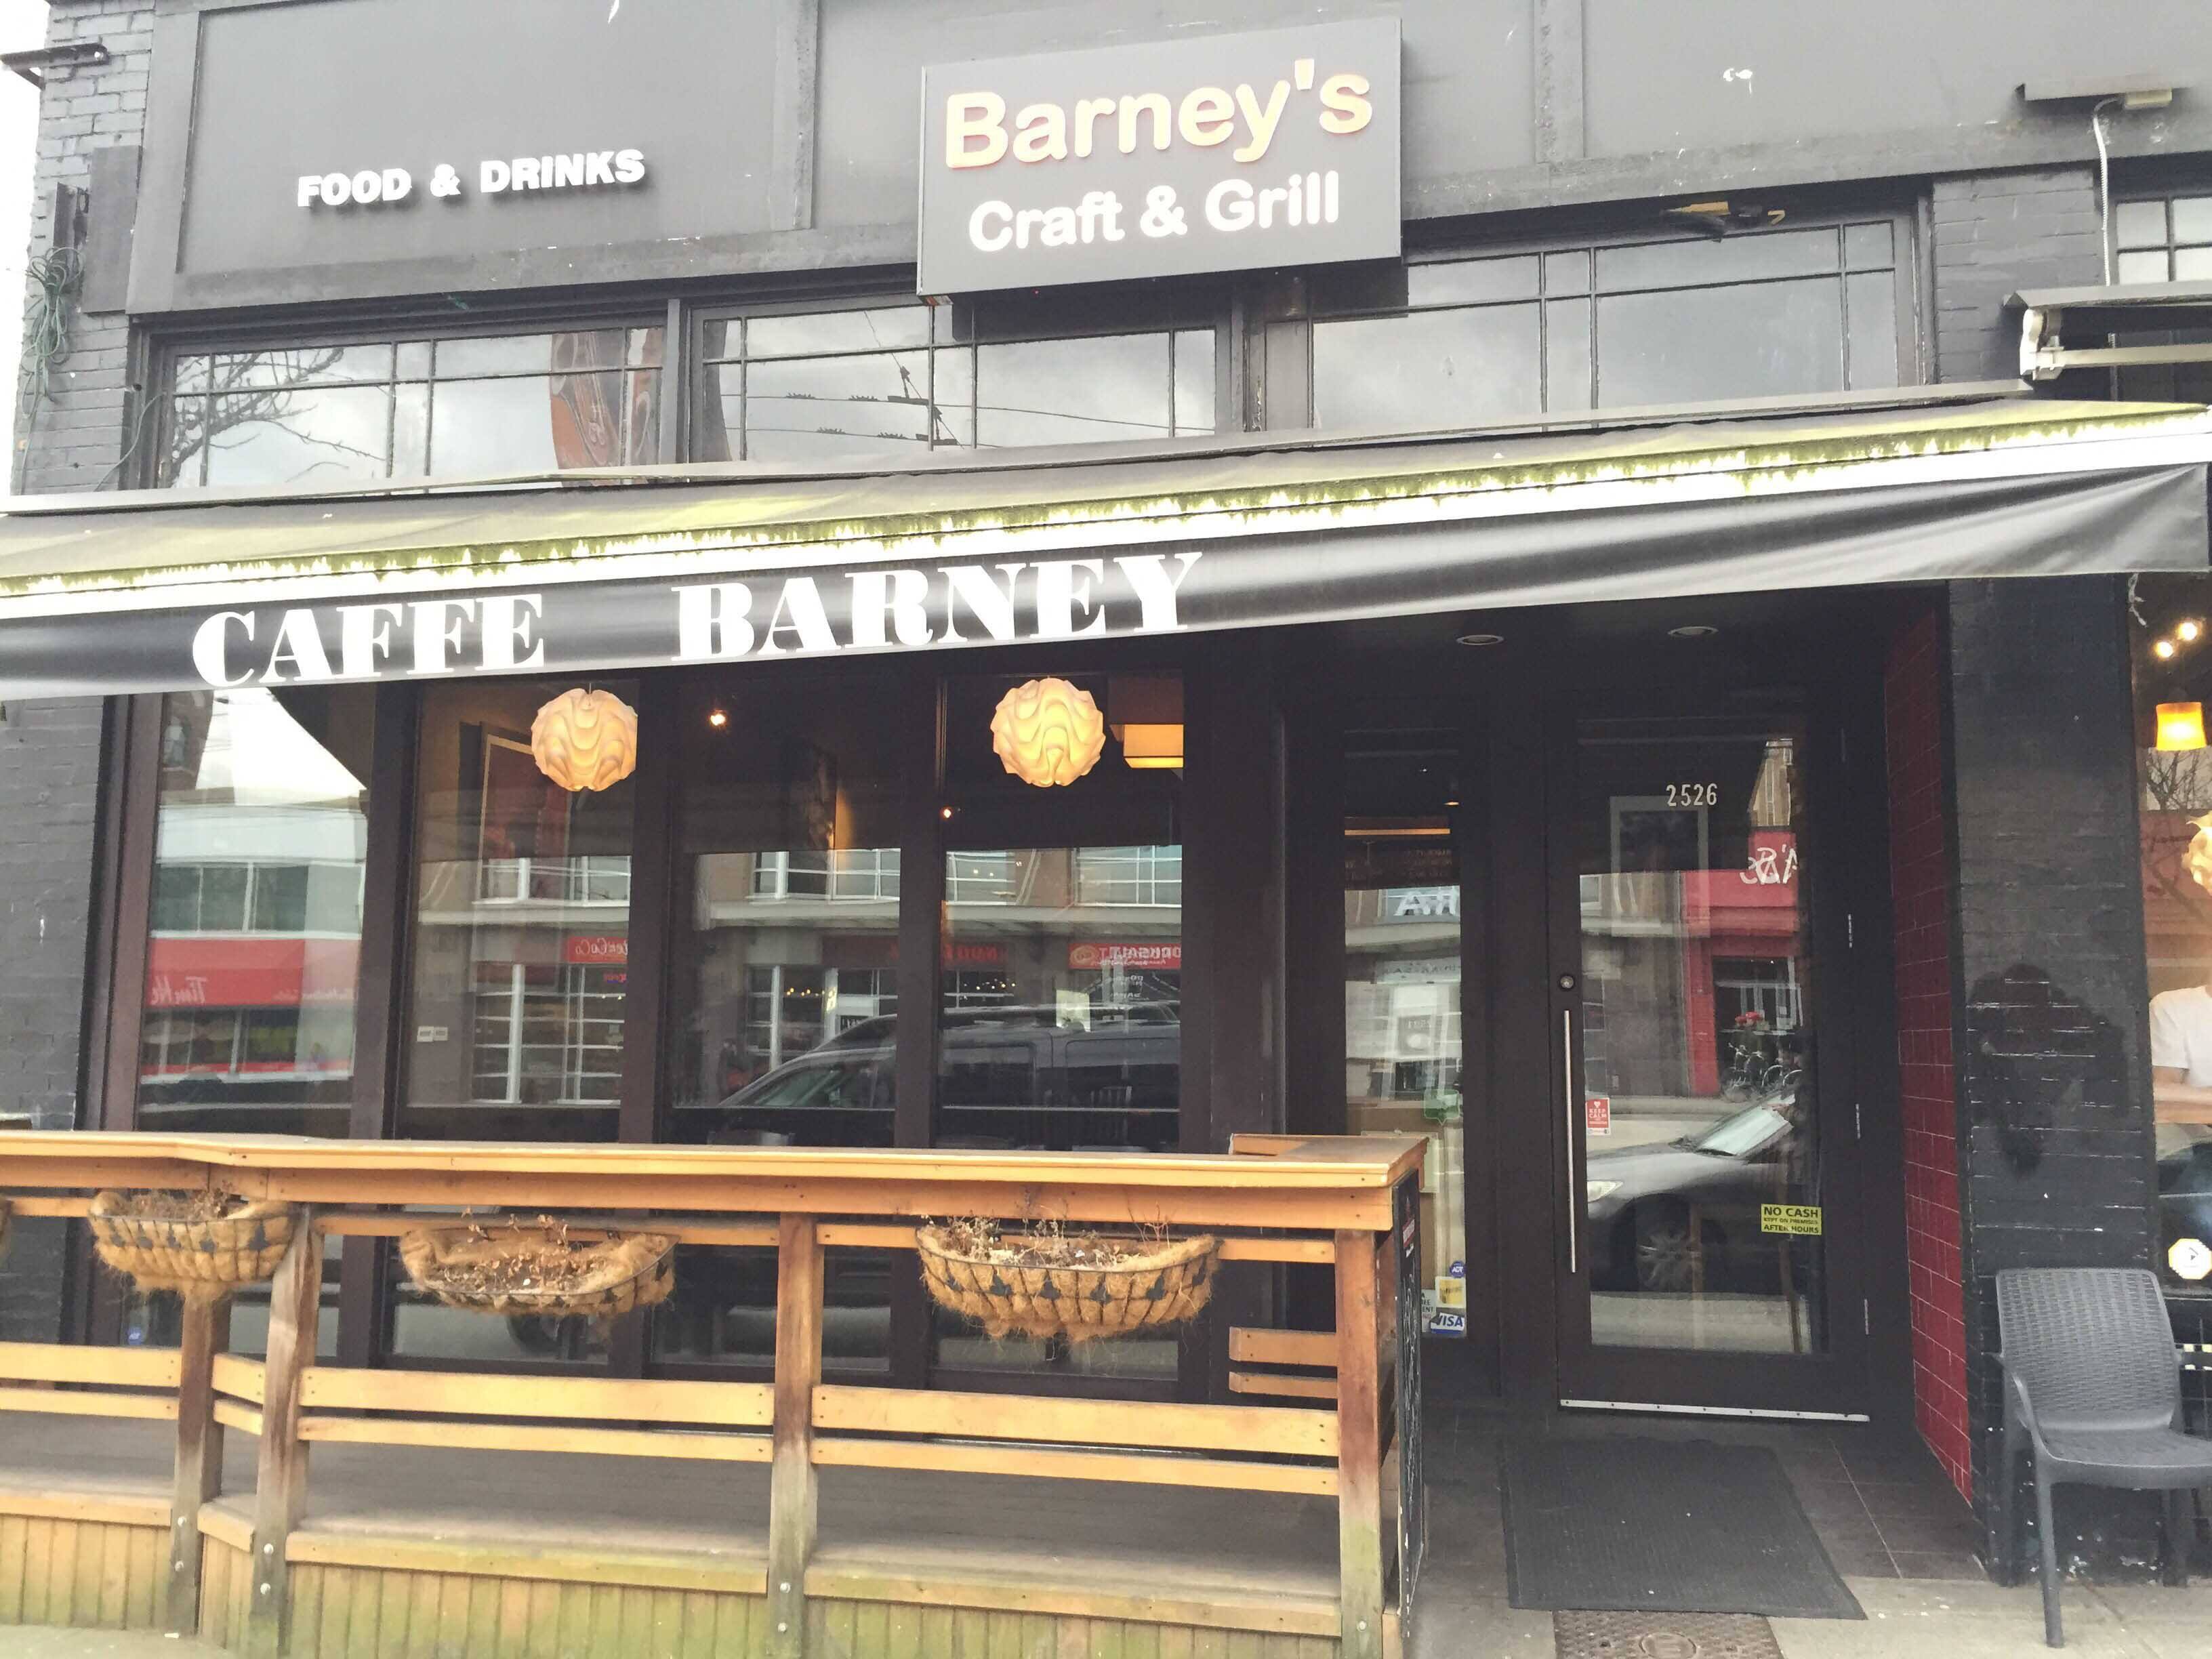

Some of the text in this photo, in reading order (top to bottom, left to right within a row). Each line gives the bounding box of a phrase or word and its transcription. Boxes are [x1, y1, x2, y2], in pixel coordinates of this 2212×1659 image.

[946, 58, 1372, 168] Barney's
[298, 149, 644, 207] FOOD & DRINKS
[969, 170, 1339, 251] Craft & Grill
[192, 552, 1202, 687] CAFFE BARNEY
[1666, 783, 1717, 806] 2526
[1764, 1207, 1818, 1218] NO CASH
